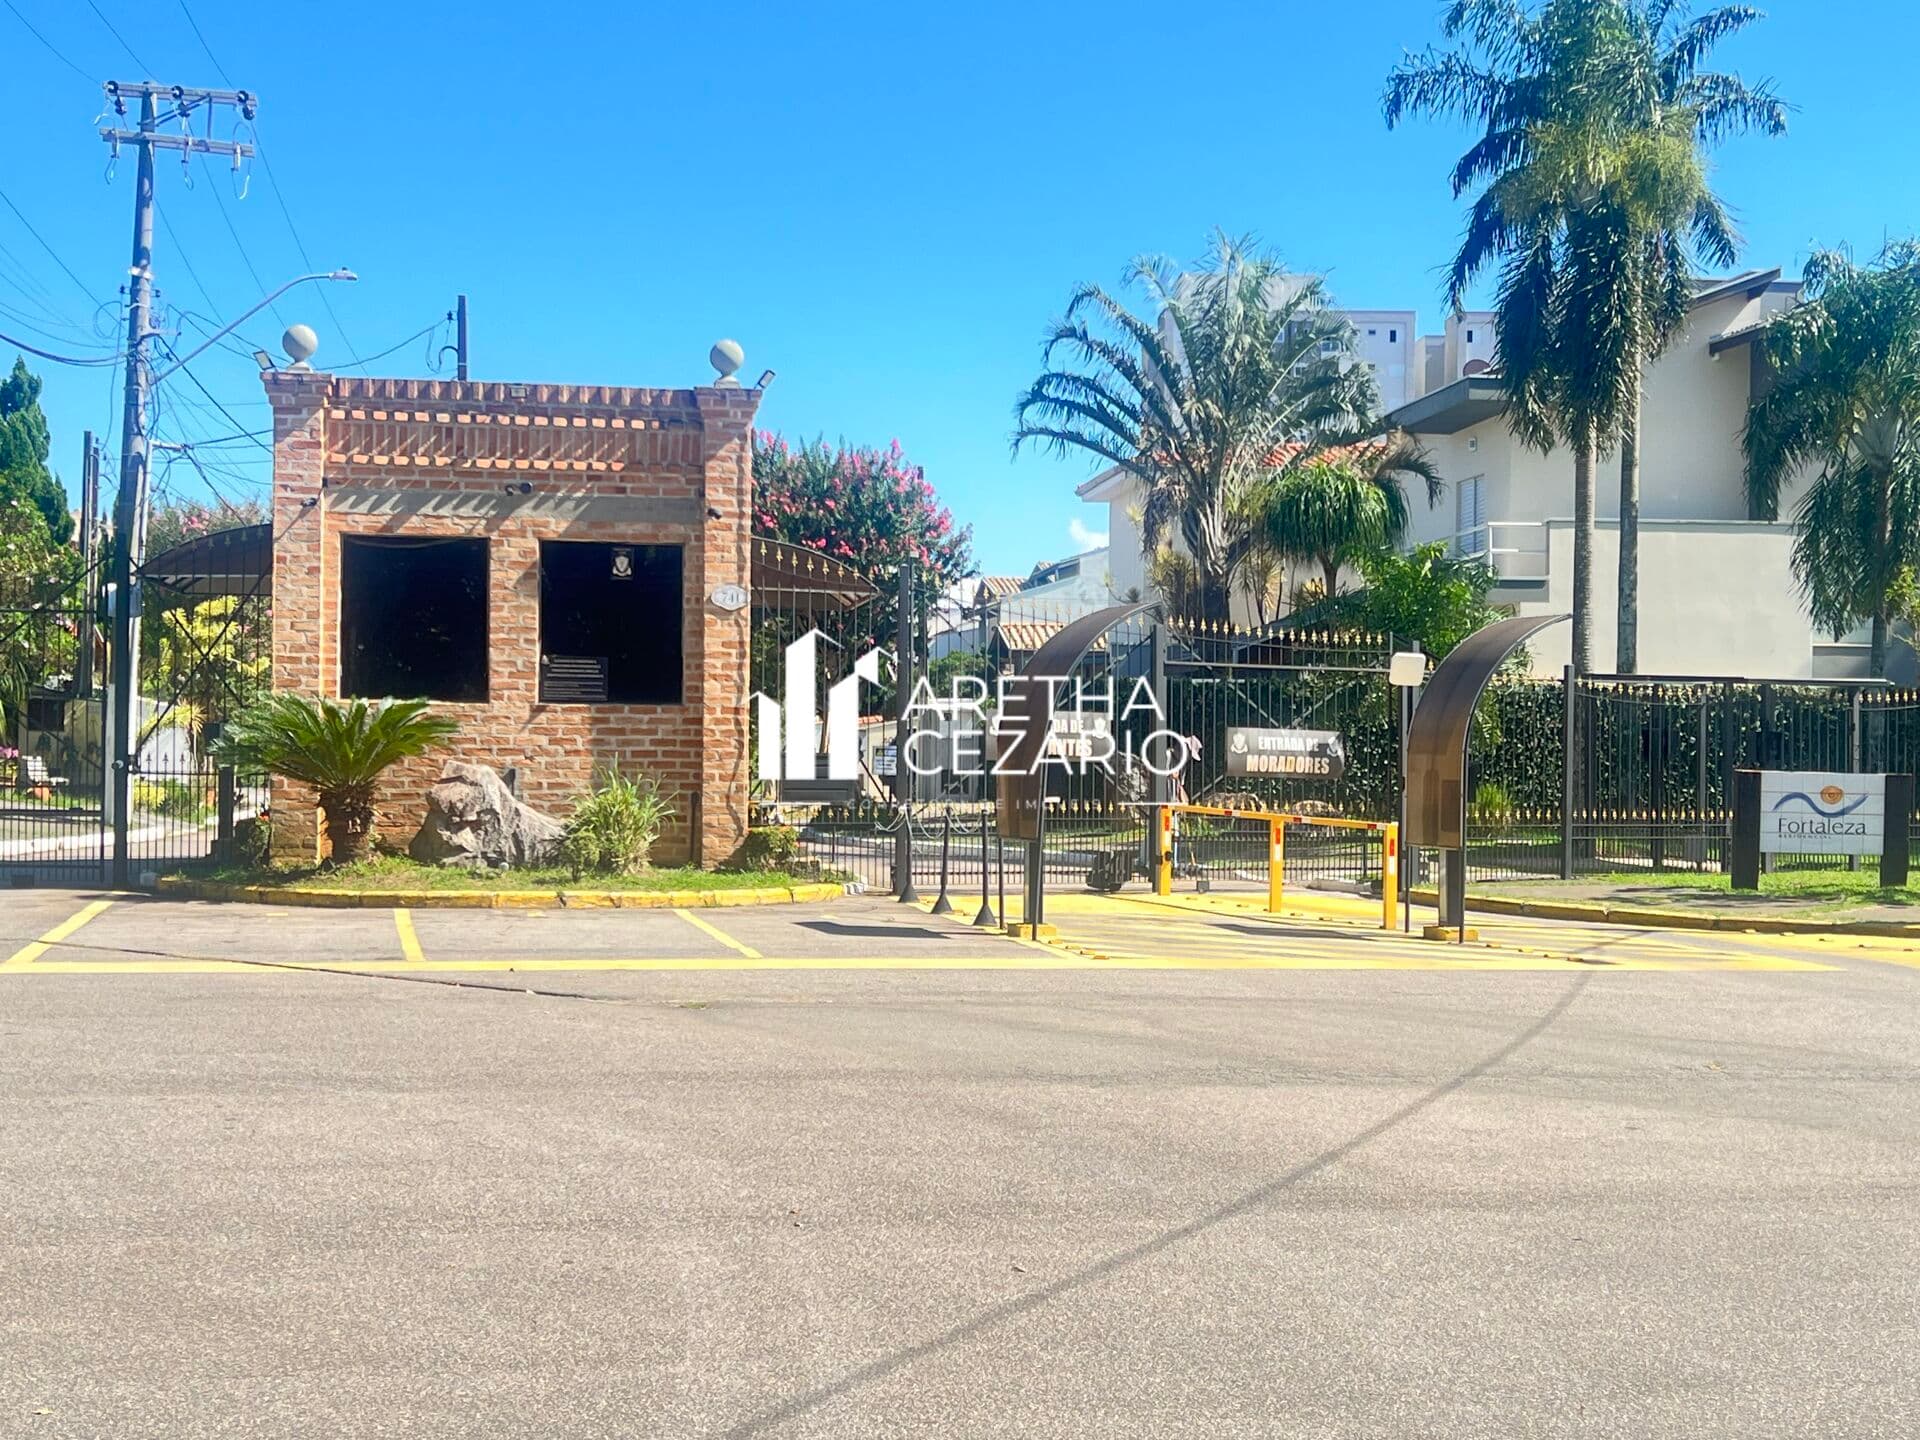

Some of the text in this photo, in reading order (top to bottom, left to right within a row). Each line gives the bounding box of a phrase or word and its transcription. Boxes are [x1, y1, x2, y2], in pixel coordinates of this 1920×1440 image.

[1258, 736, 1305, 752] ENTRADA
[1246, 754, 1330, 775] MORADORES
[1778, 817, 1867, 836] Fortaleza
